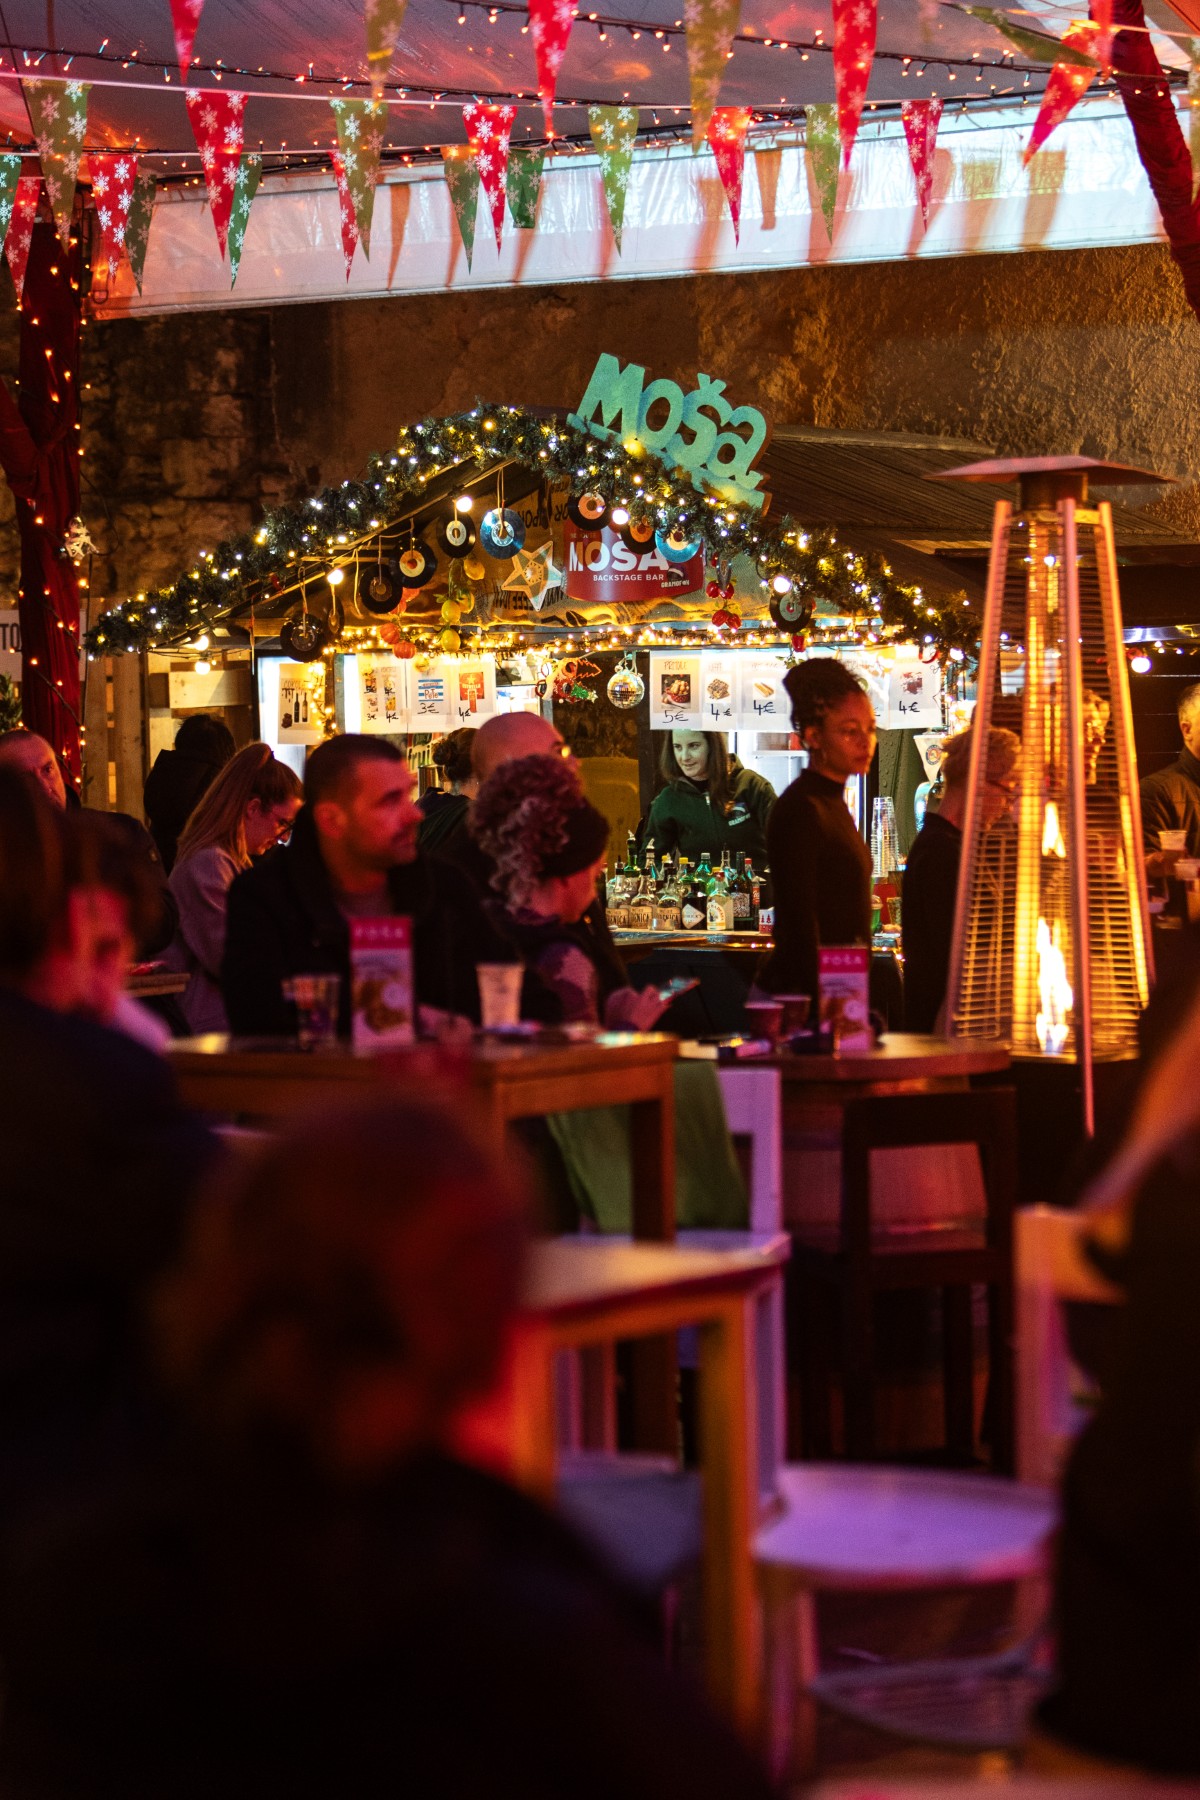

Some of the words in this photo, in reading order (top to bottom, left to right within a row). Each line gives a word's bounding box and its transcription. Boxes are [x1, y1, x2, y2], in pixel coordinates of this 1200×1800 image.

[593, 574, 643, 582] BACKSTAGE
[417, 703, 440, 715] 3€
[753, 699, 777, 716] 4€
[898, 700, 920, 715] 4€
[662, 709, 689, 723] 5€
